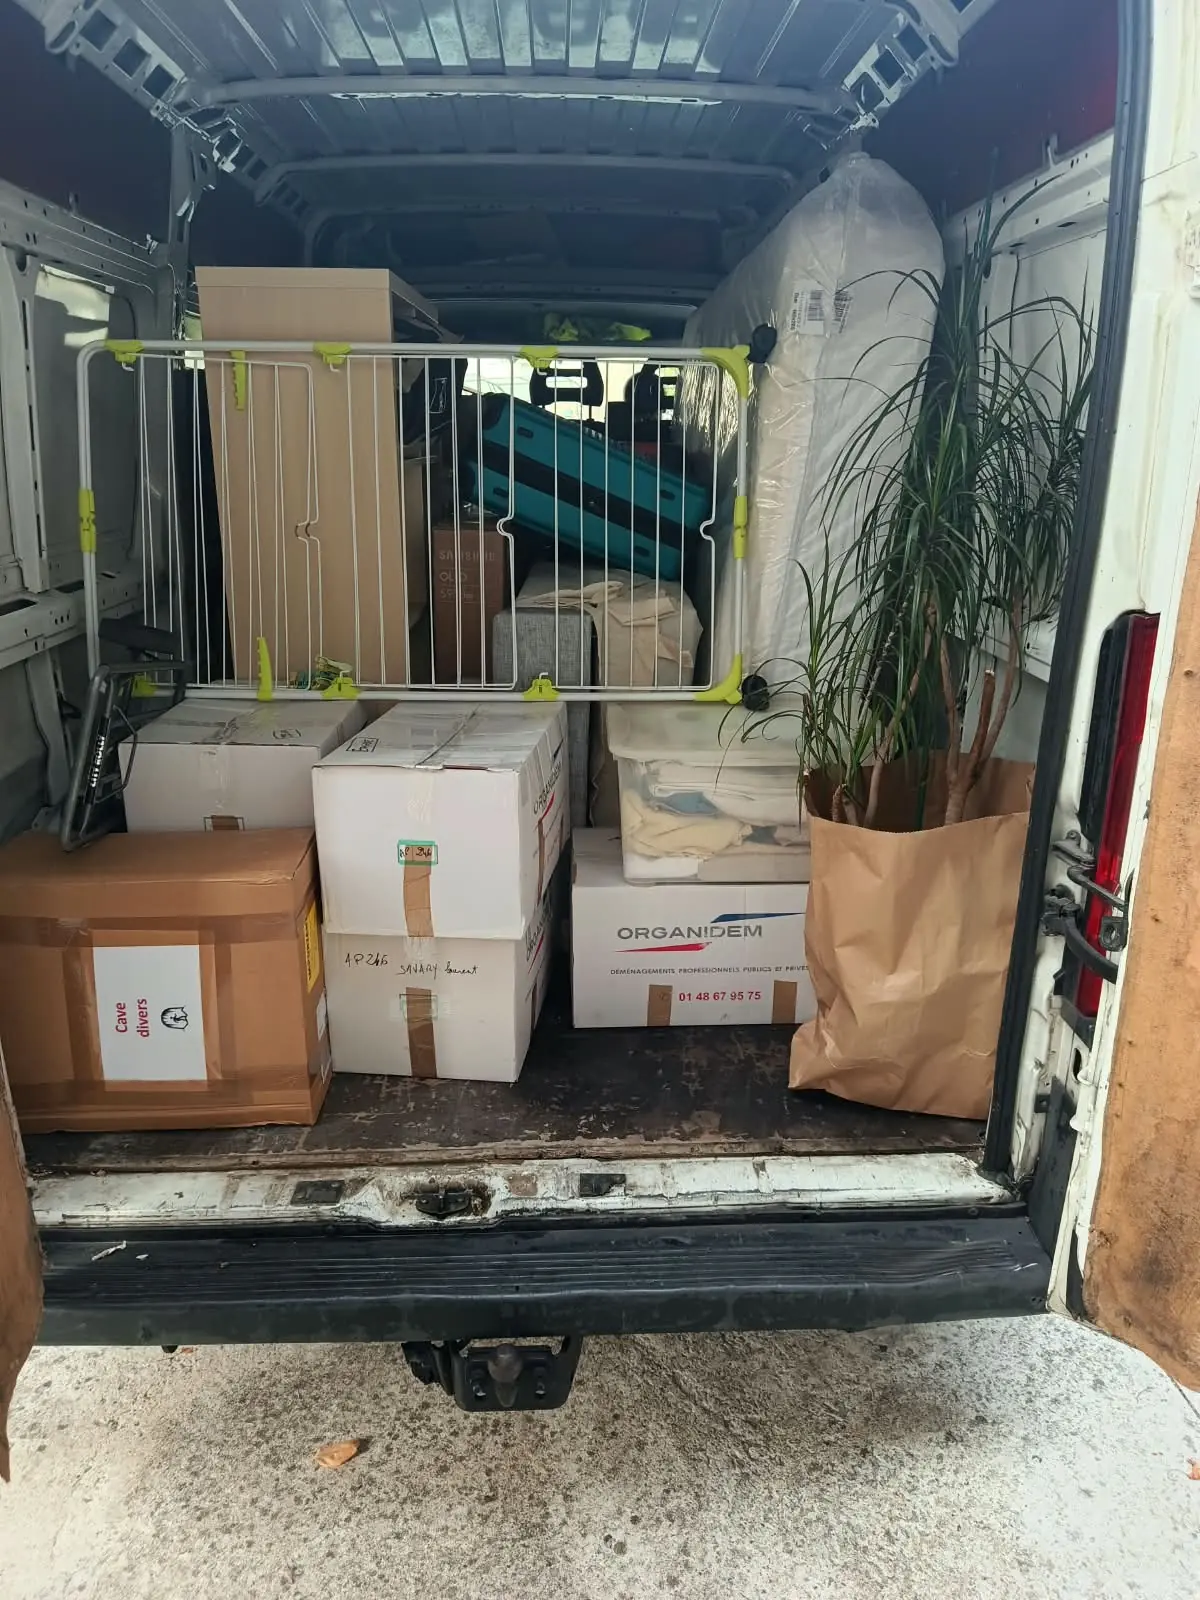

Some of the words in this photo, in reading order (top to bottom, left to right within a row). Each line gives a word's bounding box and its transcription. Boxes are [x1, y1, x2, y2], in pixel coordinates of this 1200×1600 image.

[617, 924, 763, 940] ORGANIDEM
[678, 966, 740, 975] PROFESSIONNELS
[742, 965, 772, 974] PUBLICS
[678, 992, 692, 1002] 01
[695, 992, 710, 1002] 48
[713, 991, 727, 1001] 67
[730, 991, 744, 1001] 95
[747, 990, 762, 1000] 75
[115, 1002, 128, 1033] Cave
[136, 998, 150, 1038] divers
